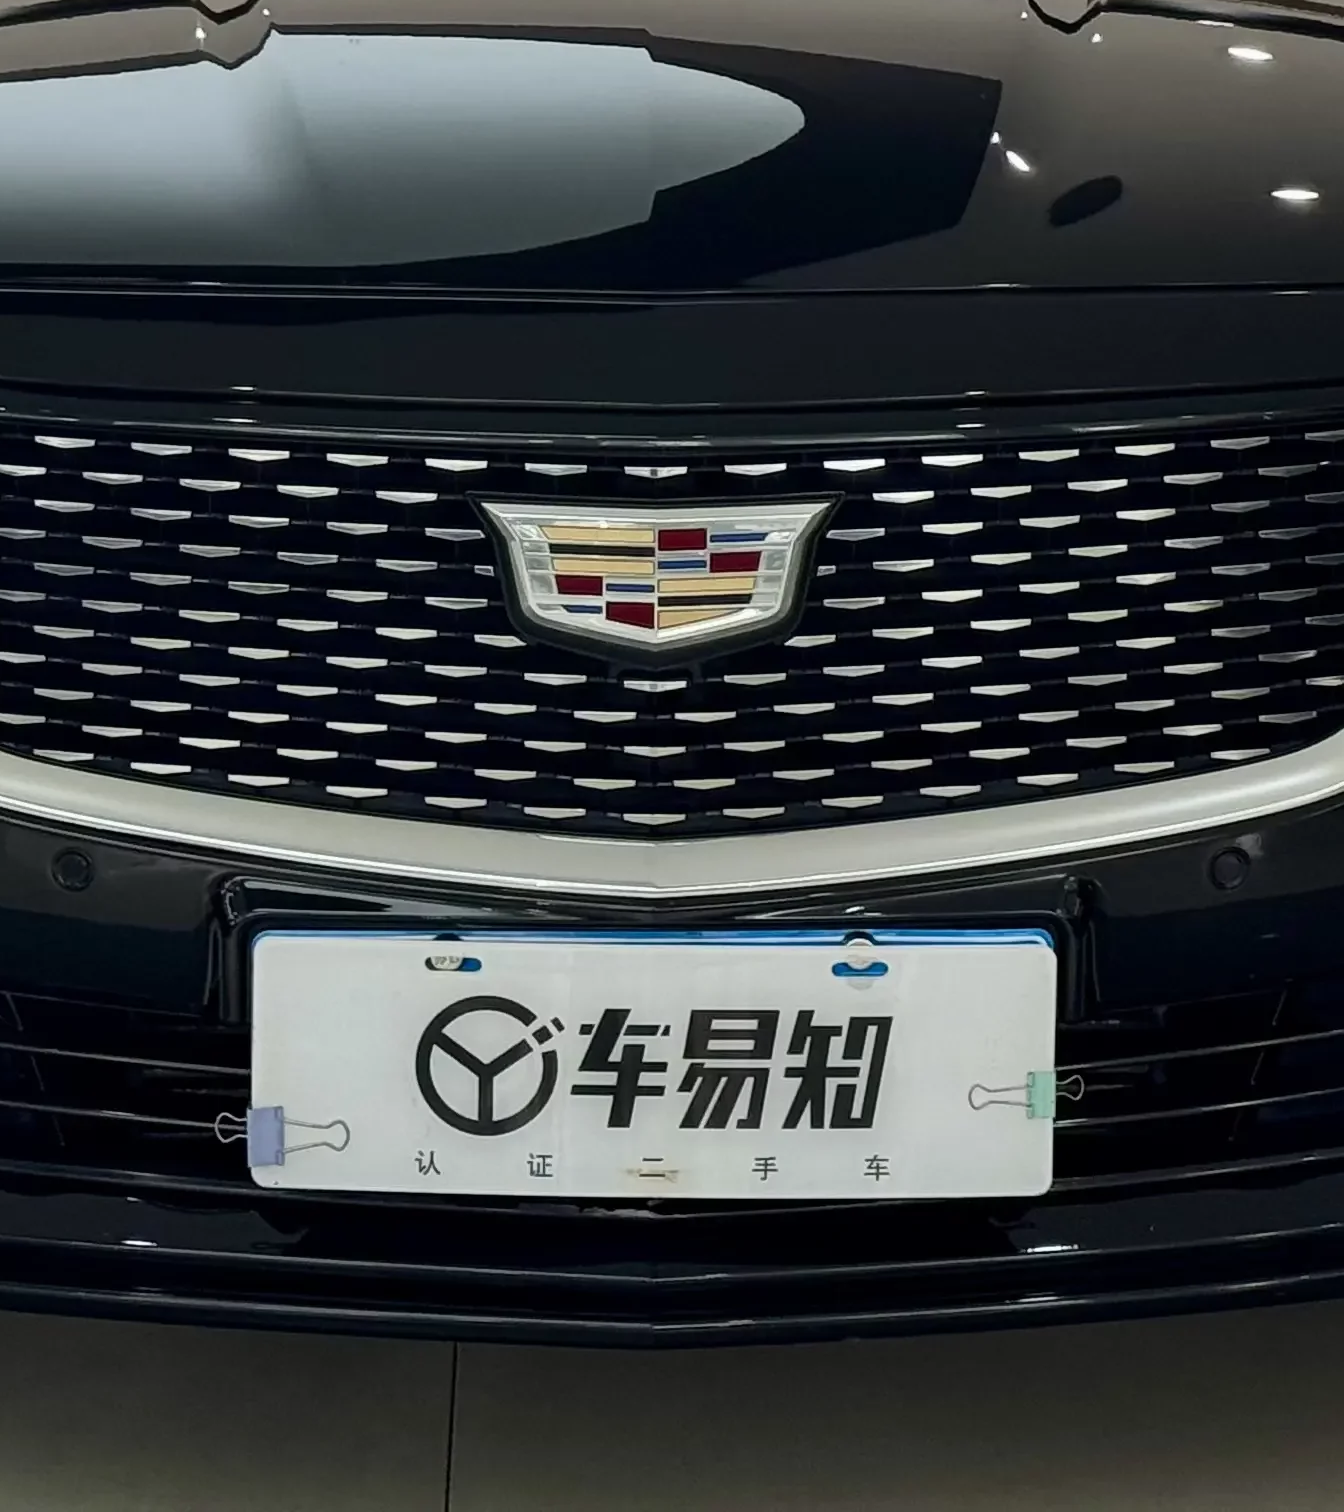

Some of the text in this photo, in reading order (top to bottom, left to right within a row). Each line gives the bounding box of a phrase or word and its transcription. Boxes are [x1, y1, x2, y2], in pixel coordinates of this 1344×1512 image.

[570, 1008, 894, 1130] 车易知
[415, 1150, 890, 1181] 认证二手车
